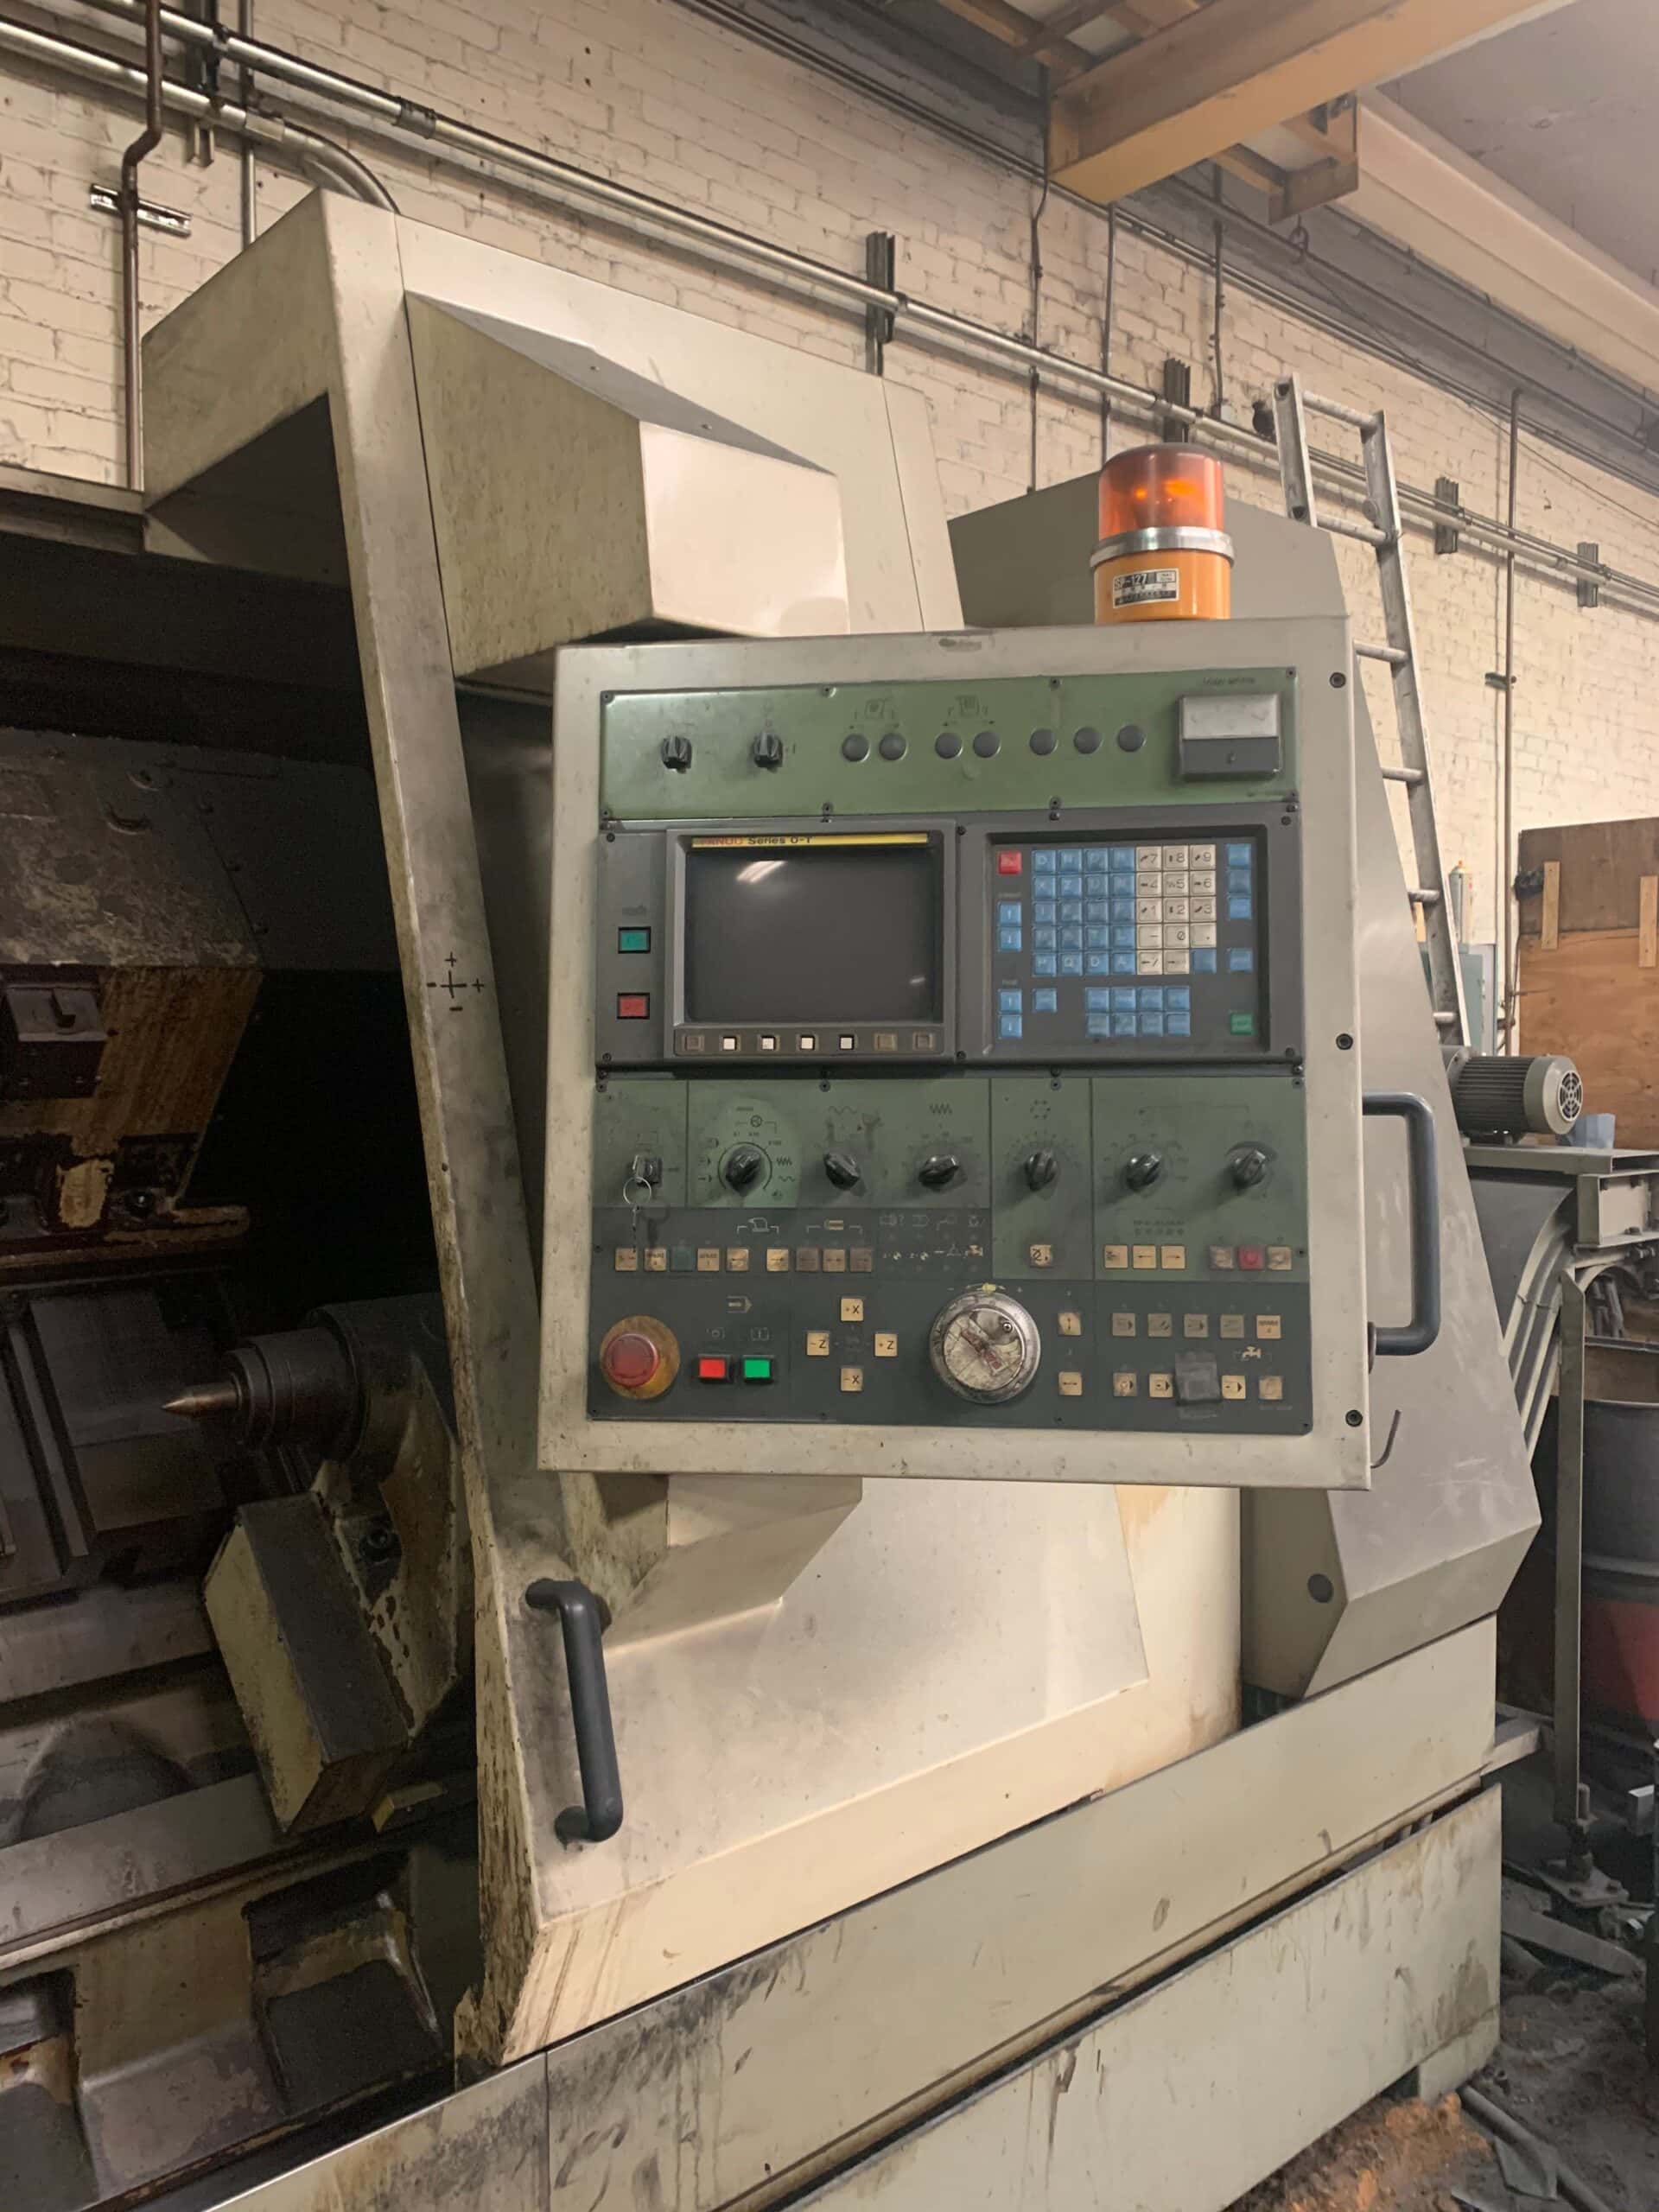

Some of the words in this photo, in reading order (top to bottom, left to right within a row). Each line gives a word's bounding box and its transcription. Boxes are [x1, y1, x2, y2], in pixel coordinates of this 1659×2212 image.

[695, 836, 744, 845] NUC
[747, 836, 785, 845] Series
[1150, 854, 1158, 863] 7
[1176, 853, 1185, 862] 8
[1203, 852, 1211, 862] 9
[1150, 880, 1158, 888] 4
[1176, 879, 1185, 888] 5
[1204, 878, 1212, 888] 6
[1177, 905, 1185, 914] 2
[1204, 905, 1212, 914] 3
[1177, 931, 1185, 940] 0
